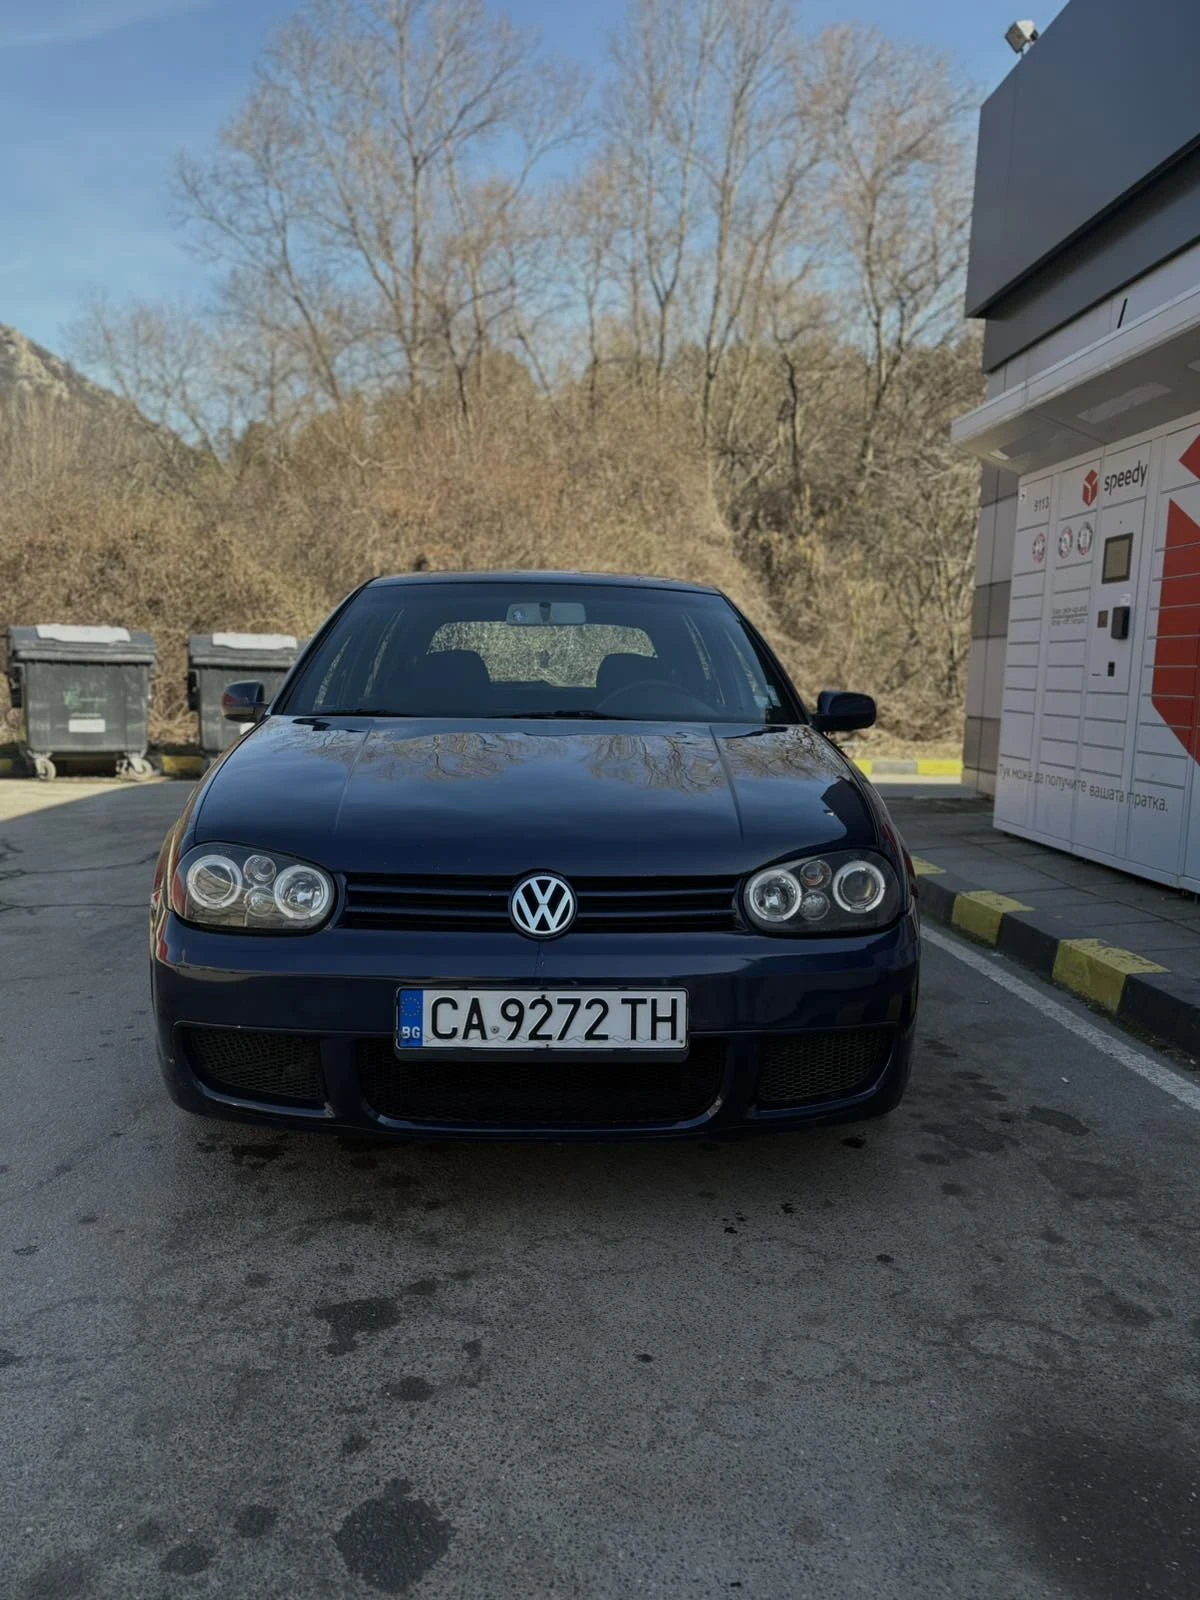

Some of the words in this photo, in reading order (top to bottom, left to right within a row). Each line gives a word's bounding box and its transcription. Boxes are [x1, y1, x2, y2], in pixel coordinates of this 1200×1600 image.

[1104, 460, 1148, 495] speedy
[1045, 774, 1087, 792] получите
[1089, 785, 1124, 802] вашата
[401, 1026, 421, 1039] BG
[431, 997, 487, 1041] CA
[500, 997, 609, 1041] 9272
[620, 997, 677, 1041] TH
